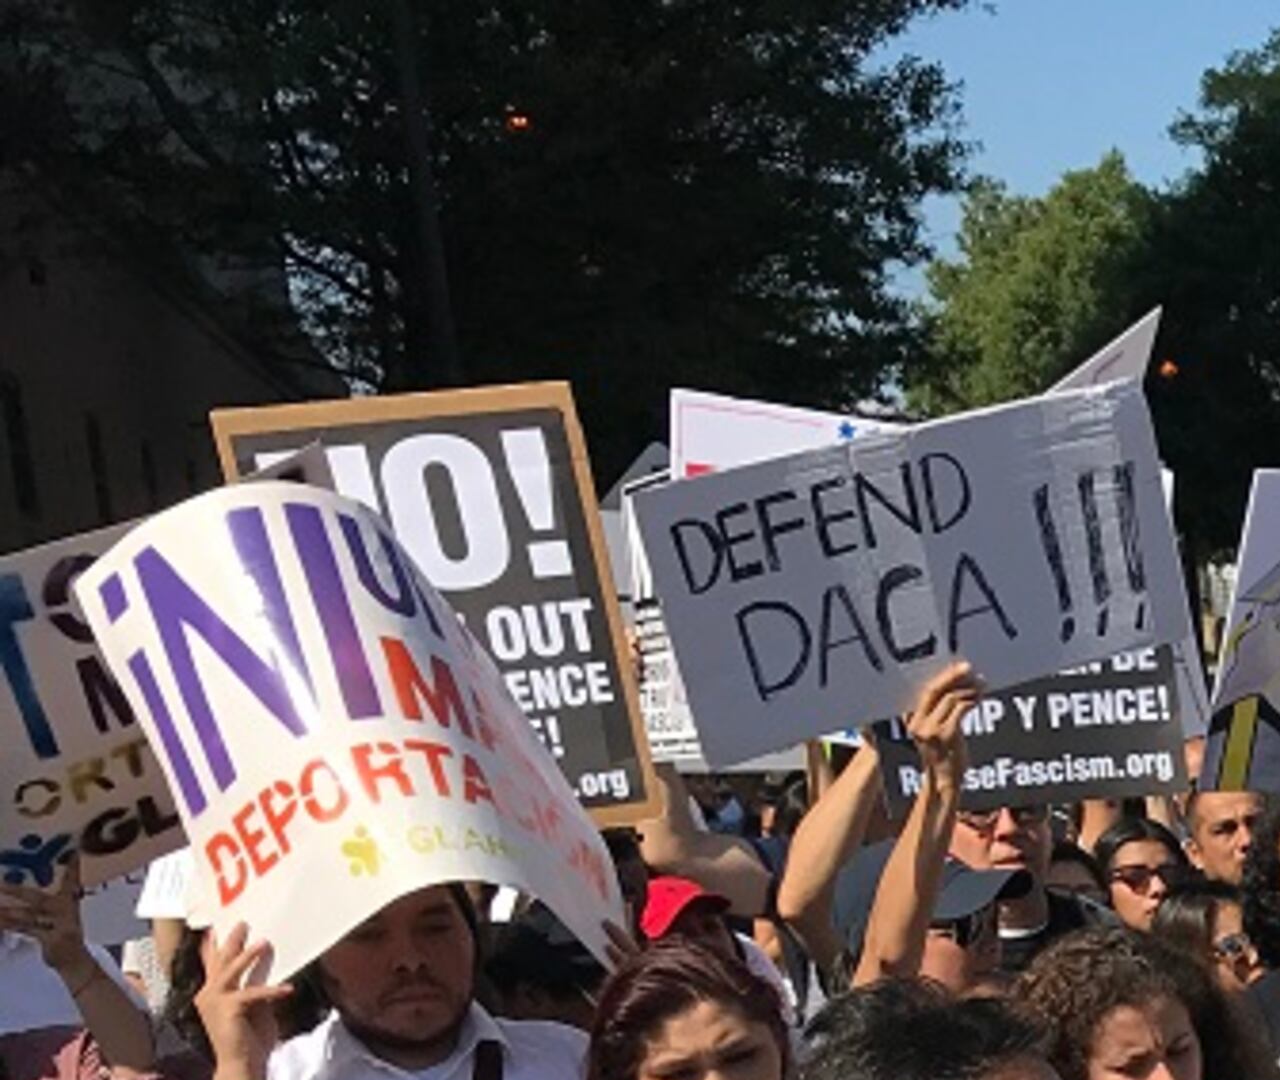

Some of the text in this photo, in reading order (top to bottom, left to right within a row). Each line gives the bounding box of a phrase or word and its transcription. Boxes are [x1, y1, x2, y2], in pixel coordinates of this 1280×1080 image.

[670, 452, 972, 595] DEFEND
[487, 598, 594, 661] OUT
[736, 552, 1017, 702] DACA
[1012, 697, 1036, 731] Y
[1047, 686, 1170, 728] PENCE!
